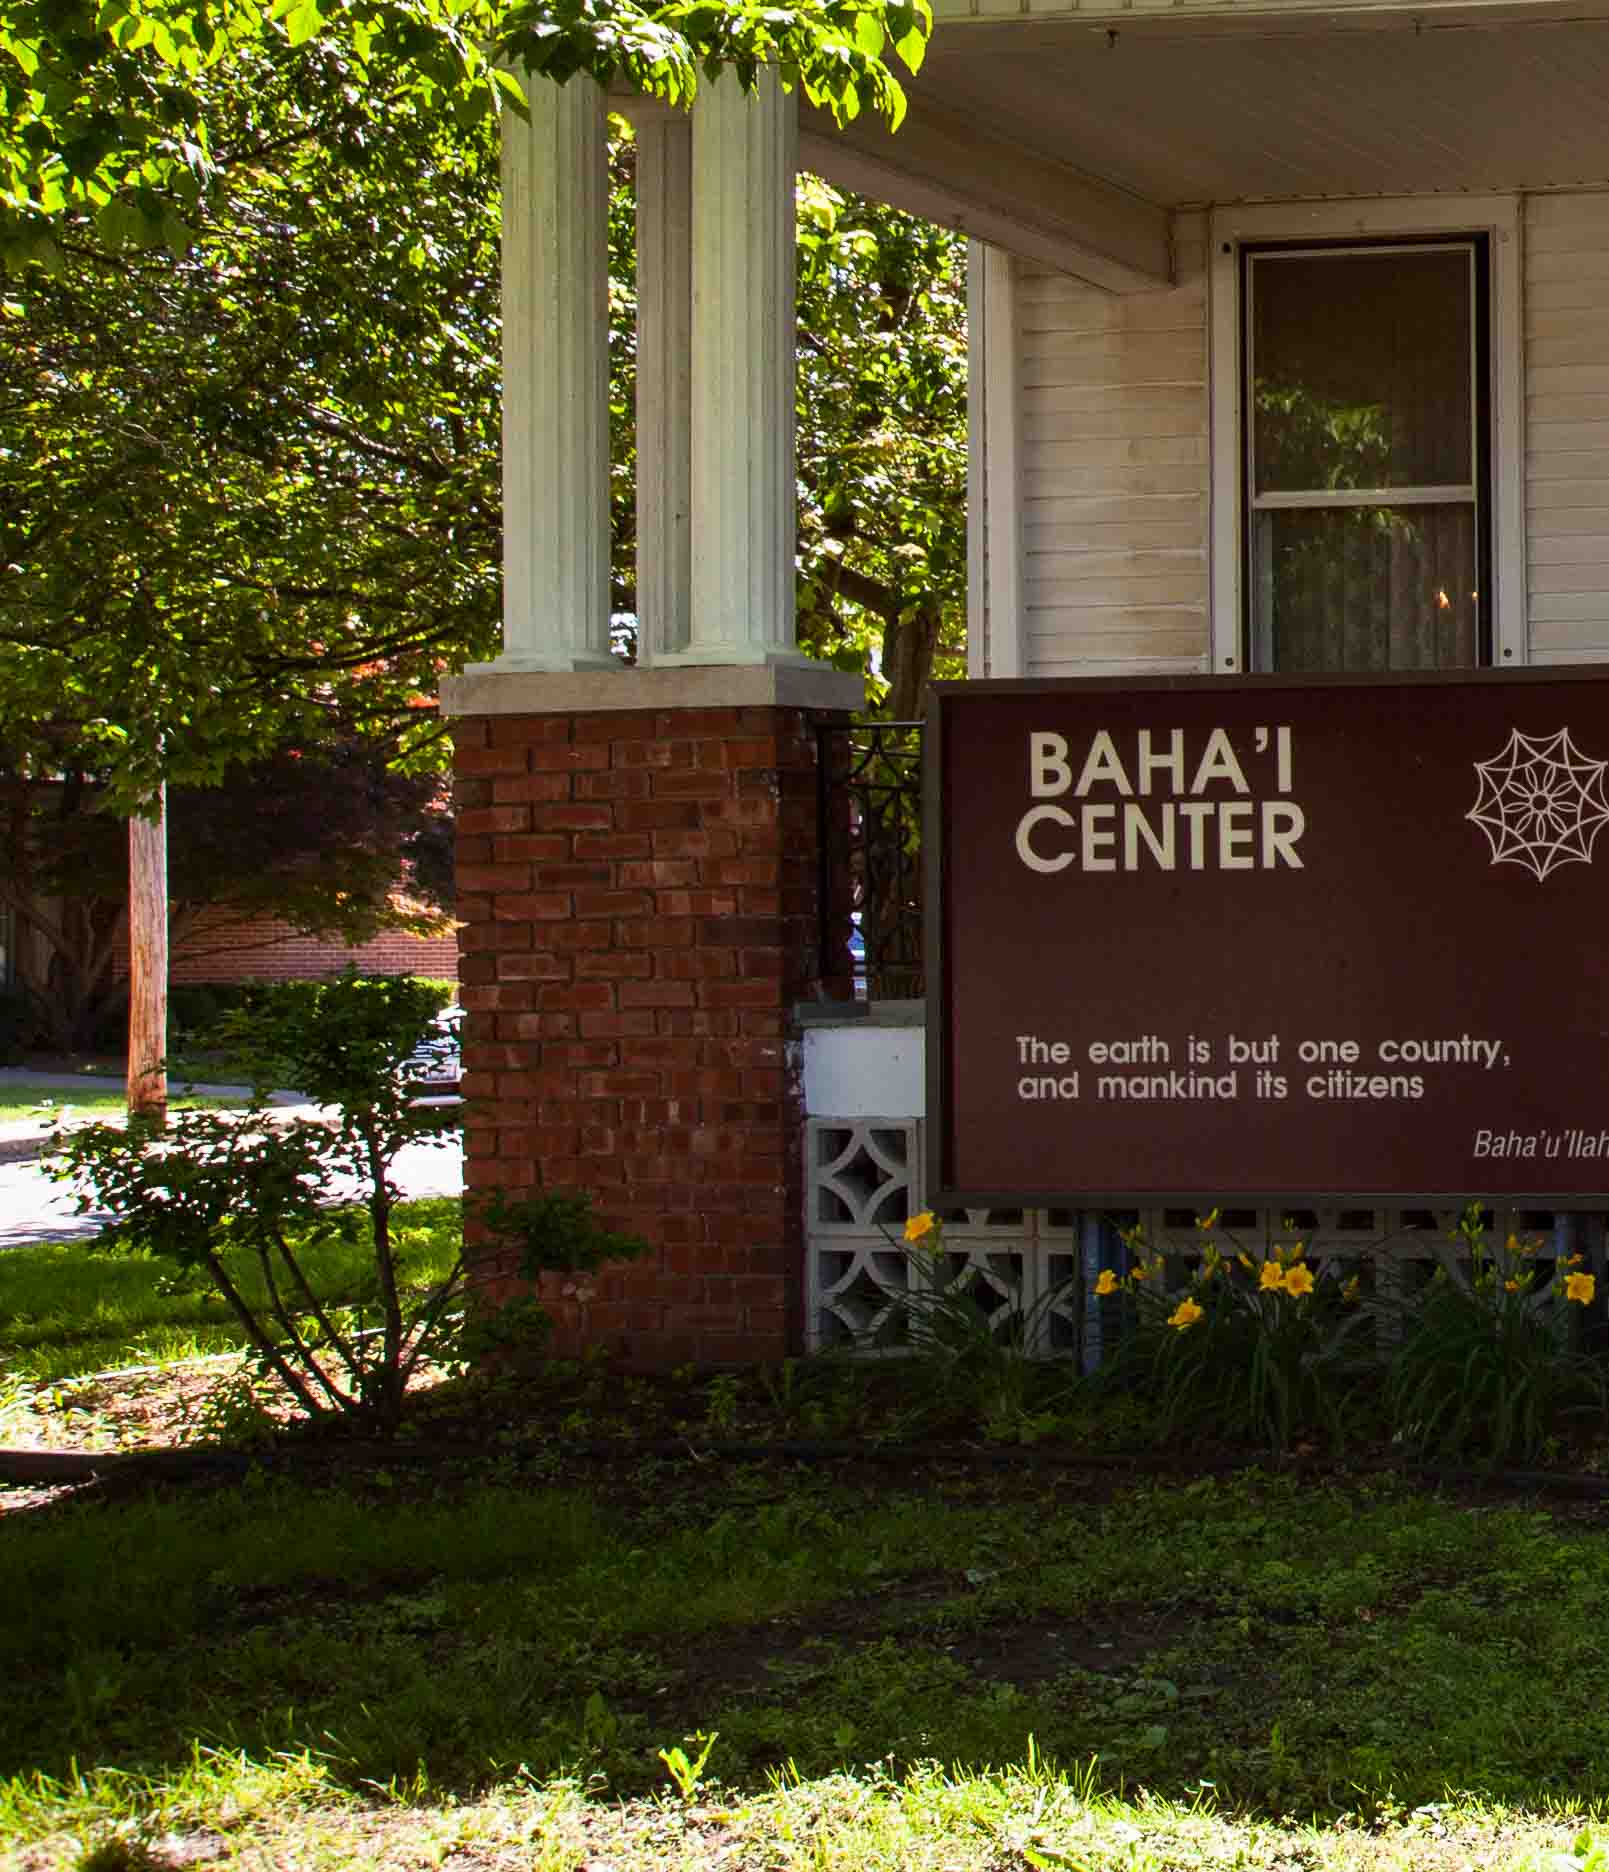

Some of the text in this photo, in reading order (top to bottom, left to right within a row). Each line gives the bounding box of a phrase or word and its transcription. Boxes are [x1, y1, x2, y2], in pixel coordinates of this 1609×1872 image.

[1031, 727, 1293, 797] BAHA'I
[1015, 801, 1305, 873] CENTER
[1016, 1034, 1510, 1070] The earth is but one country,
[1018, 1070, 1424, 1099] and mankind its citizens
